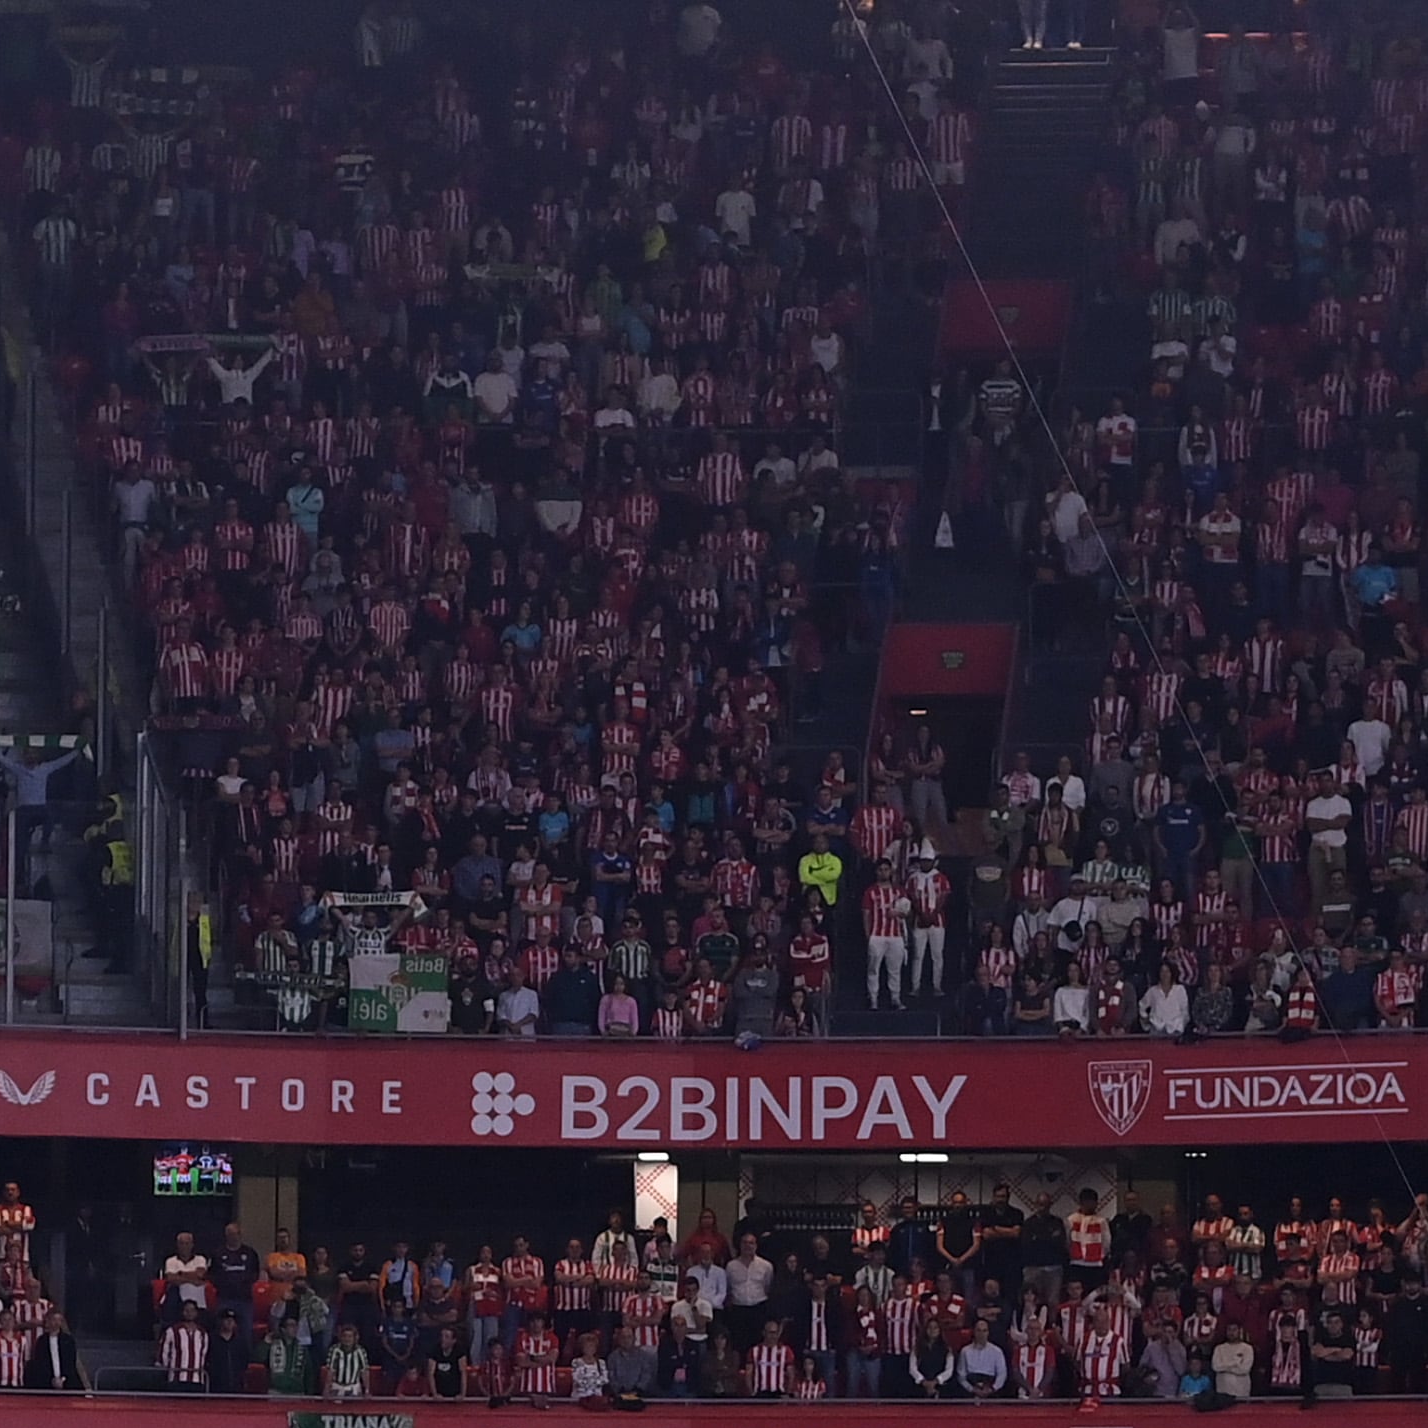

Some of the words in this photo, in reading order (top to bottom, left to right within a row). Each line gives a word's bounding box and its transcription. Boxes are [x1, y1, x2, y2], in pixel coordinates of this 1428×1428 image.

[87, 1072, 402, 1114] CASTORE
[561, 1075, 967, 1141] B2BINPAY
[1167, 1072, 1406, 1111] FUNDAZIOA
